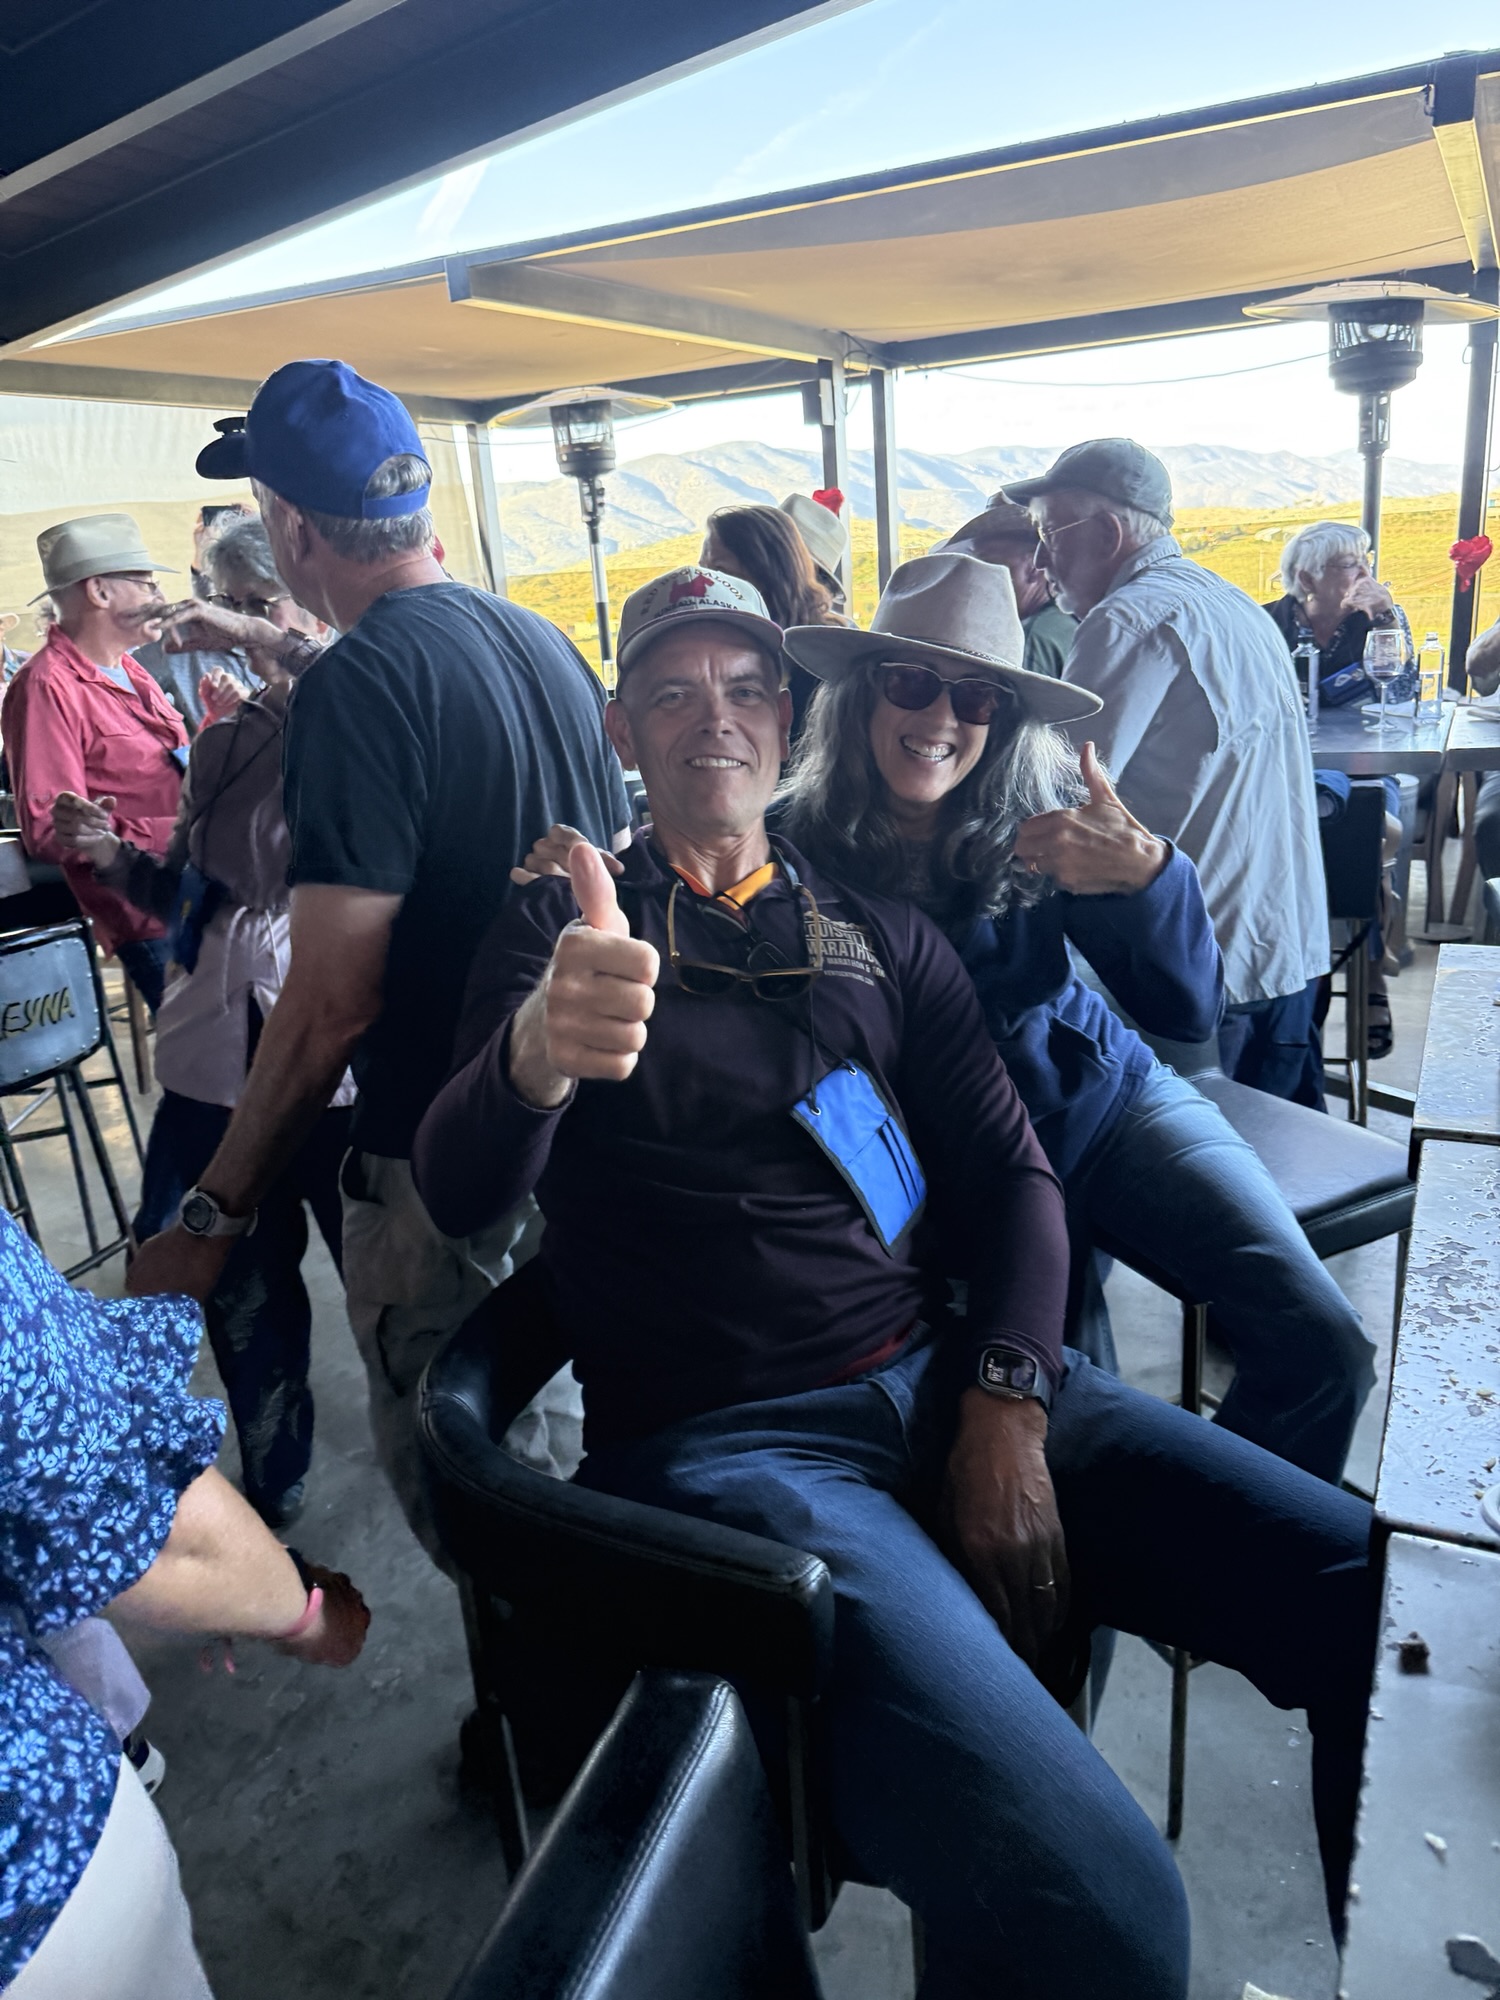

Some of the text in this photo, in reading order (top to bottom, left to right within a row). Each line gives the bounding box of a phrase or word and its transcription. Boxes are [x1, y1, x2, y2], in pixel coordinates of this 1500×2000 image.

[660, 568, 690, 587] DOG
[694, 569, 748, 602] SALOON
[699, 599, 739, 611] ALASKA
[0, 986, 76, 1040] EYNA
